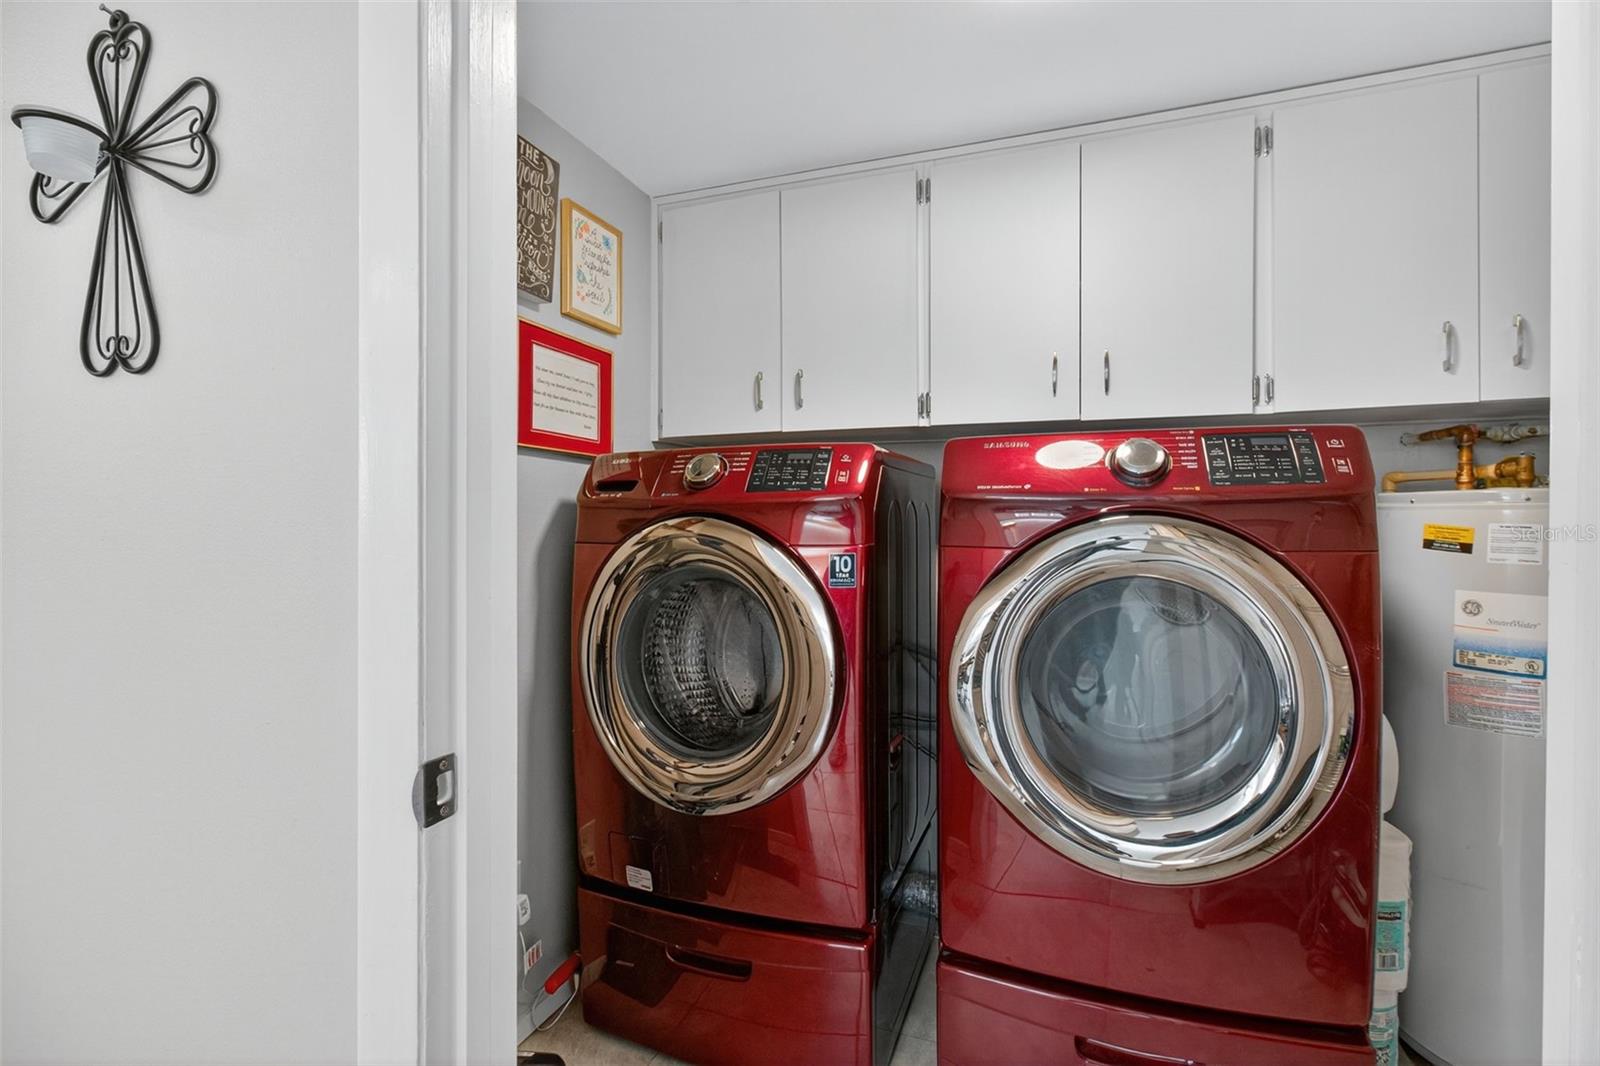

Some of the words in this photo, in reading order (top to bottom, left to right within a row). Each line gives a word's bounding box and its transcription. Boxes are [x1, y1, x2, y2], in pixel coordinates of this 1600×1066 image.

[518, 139, 540, 164] THE
[983, 441, 1030, 449] SAMSUNG
[833, 555, 852, 573] 10
